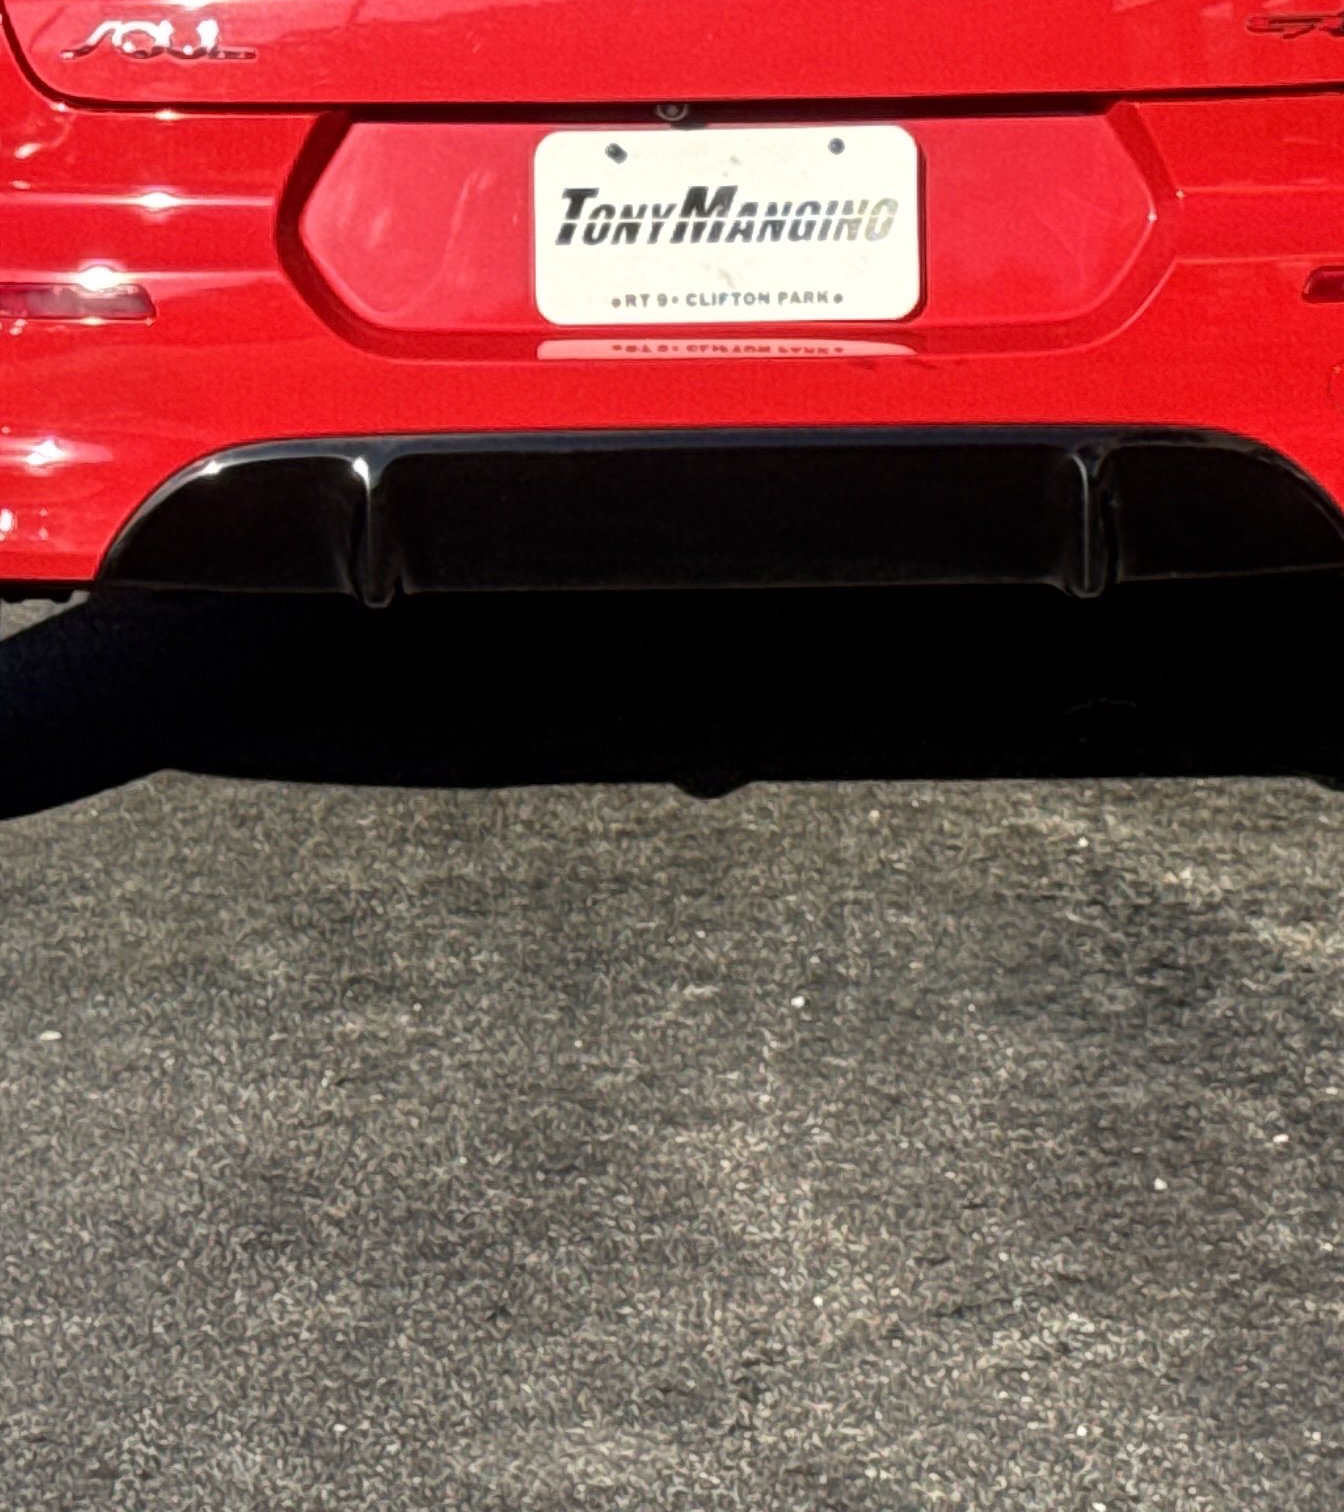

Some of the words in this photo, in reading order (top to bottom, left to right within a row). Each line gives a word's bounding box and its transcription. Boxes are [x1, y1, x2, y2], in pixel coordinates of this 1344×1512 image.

[555, 184, 900, 246] TONYMANGINO
[624, 293, 650, 308] RT
[685, 291, 771, 307] CLIFTON
[777, 290, 829, 305] PARK
